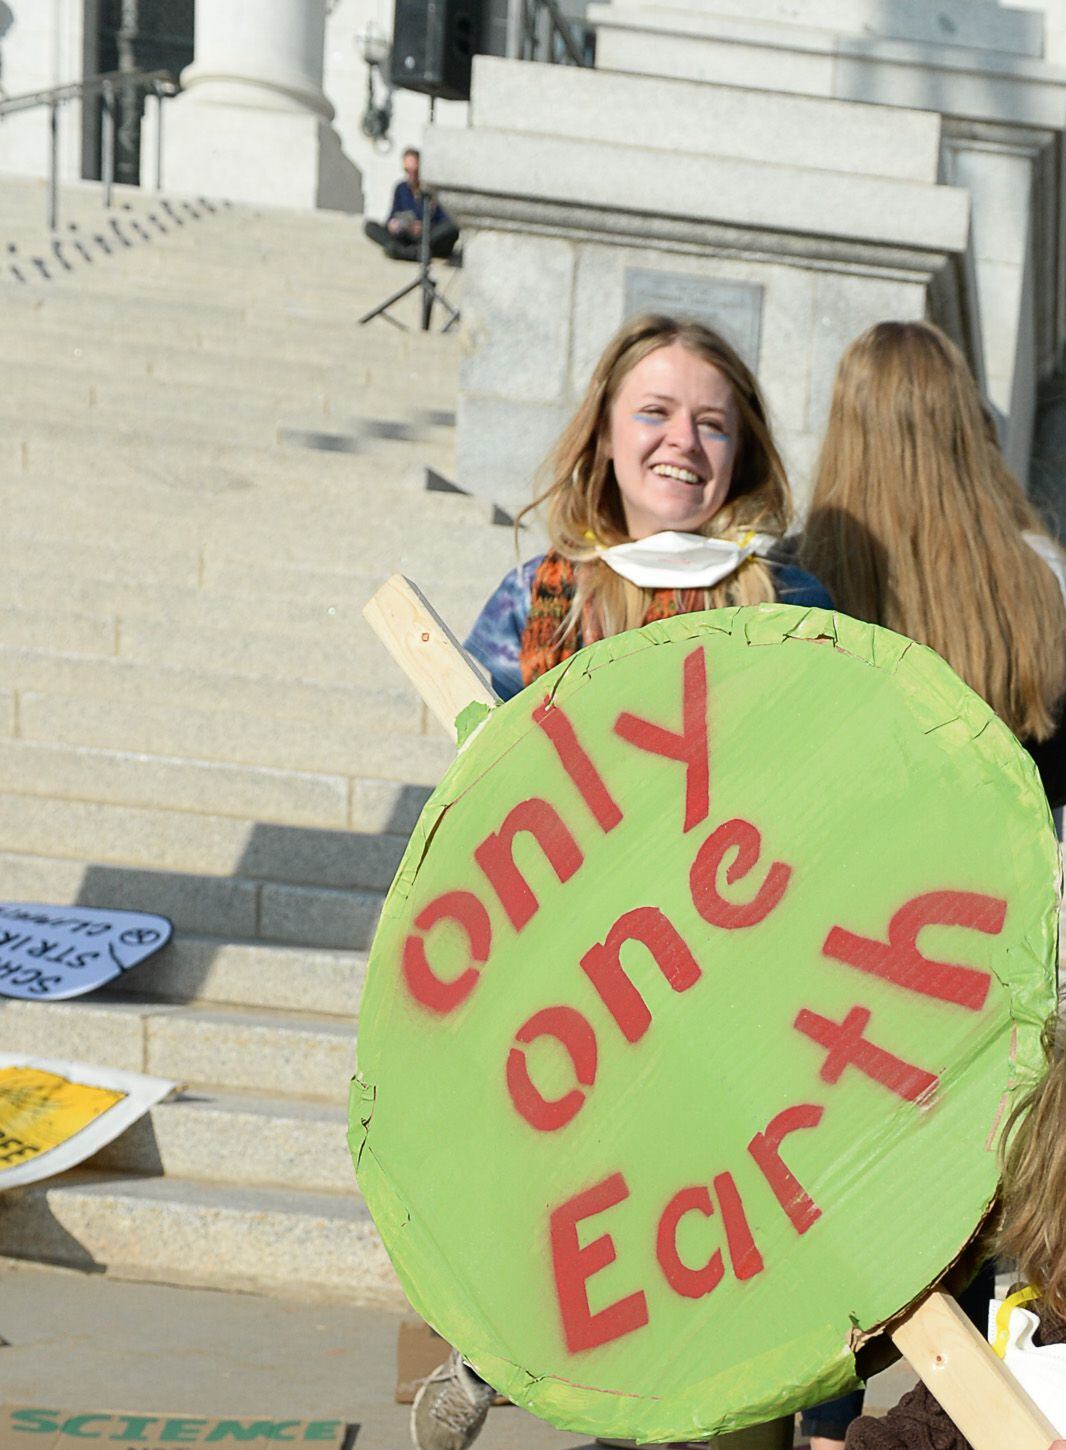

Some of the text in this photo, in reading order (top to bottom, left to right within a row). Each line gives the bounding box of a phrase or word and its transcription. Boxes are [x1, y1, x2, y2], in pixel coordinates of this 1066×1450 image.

[403, 646, 709, 1014] only
[506, 817, 792, 1132] one
[549, 890, 1007, 1356] Earth
[10, 1408, 342, 1442] SCIENCE
